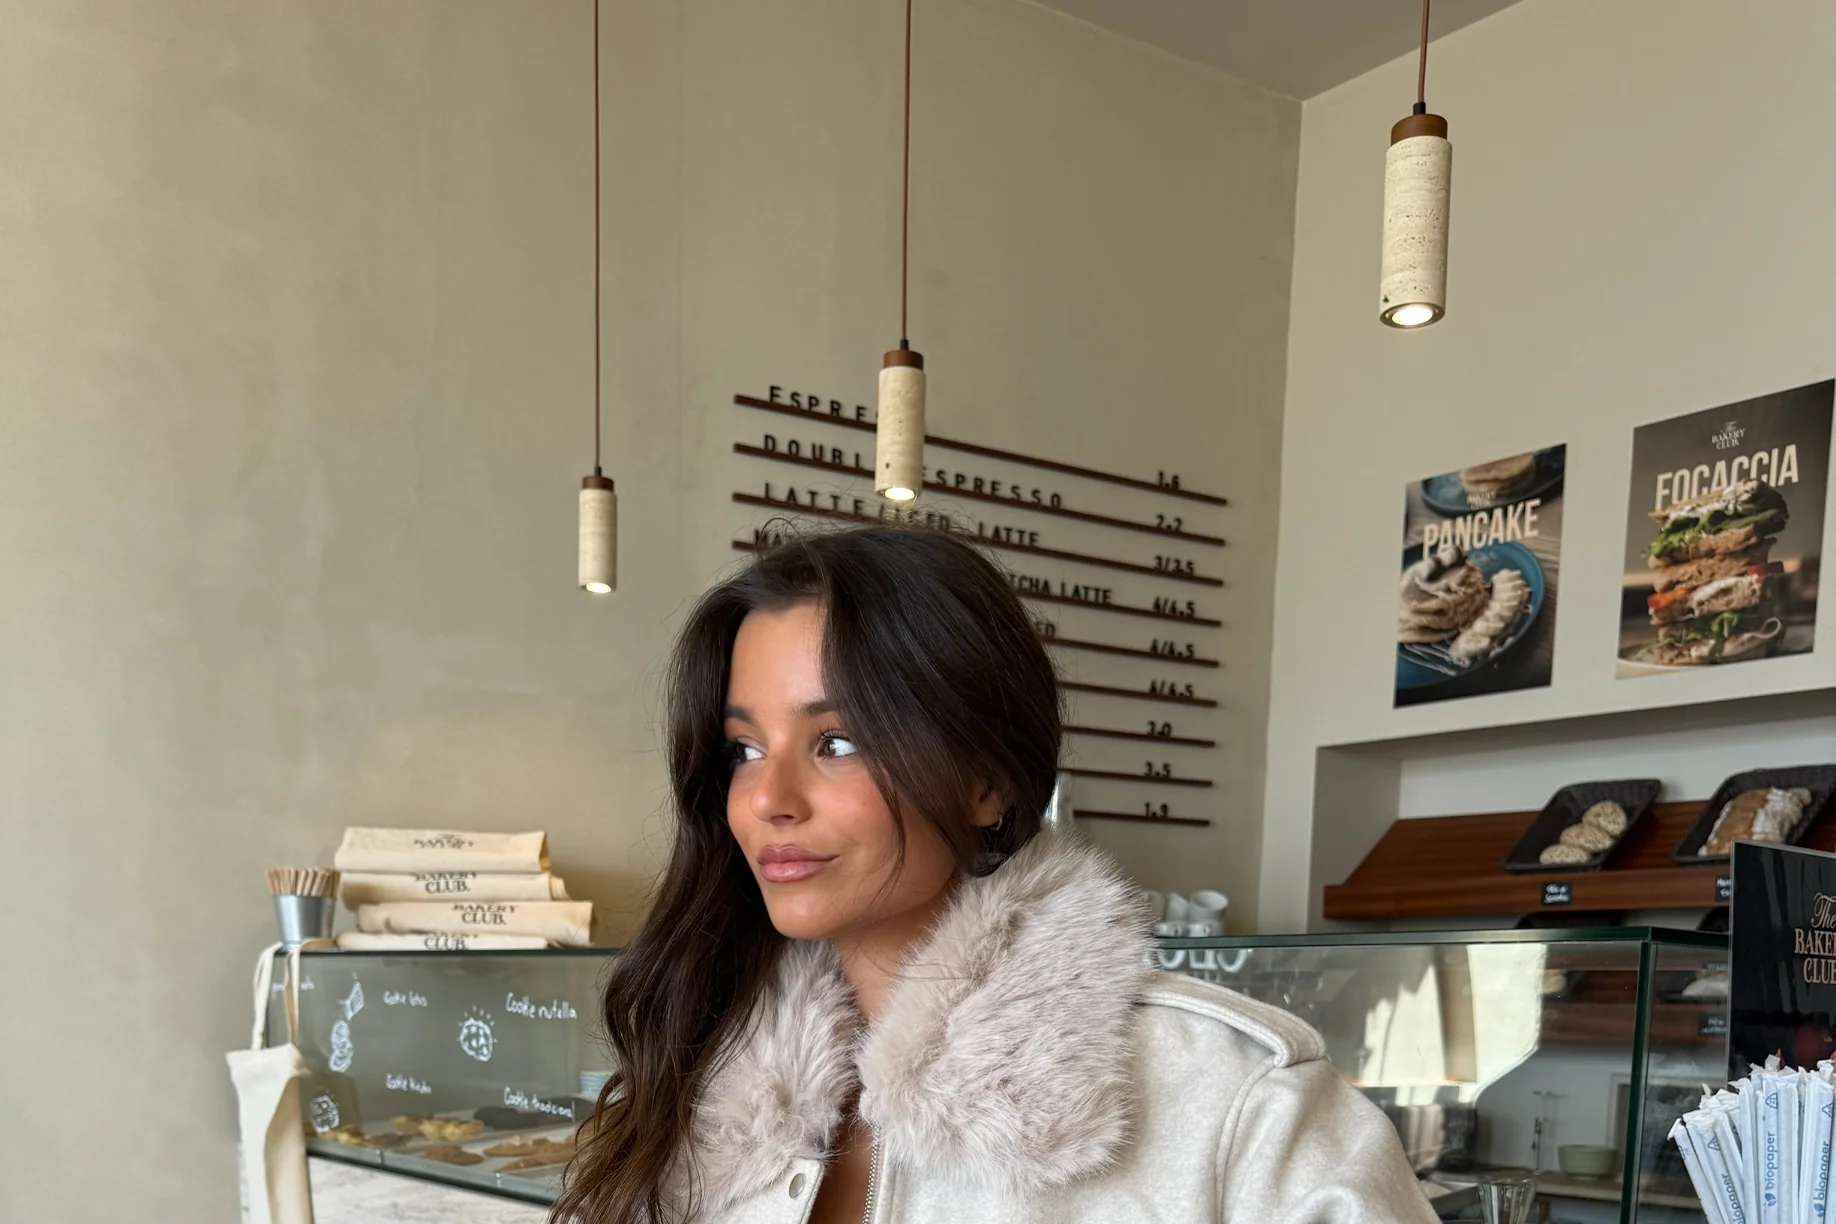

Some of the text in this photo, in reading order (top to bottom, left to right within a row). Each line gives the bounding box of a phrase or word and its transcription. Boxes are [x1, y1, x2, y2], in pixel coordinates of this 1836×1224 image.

[768, 384, 879, 421] ESPRE
[764, 433, 864, 469] DOUBL
[1156, 514, 1182, 531] 2.2
[1654, 443, 1799, 511] FOCACCIA
[978, 521, 1040, 547] LATTE
[1422, 497, 1541, 560] PANCAKE
[1008, 573, 1050, 594] TCHA
[1060, 580, 1112, 604] LATTE
[1145, 762, 1171, 778] 3.5
[1144, 802, 1169, 818] 1.9
[1794, 928, 1836, 957] BAKE
[1765, 1131, 1777, 1190] biopaper
[1812, 1140, 1830, 1201] biopaper
